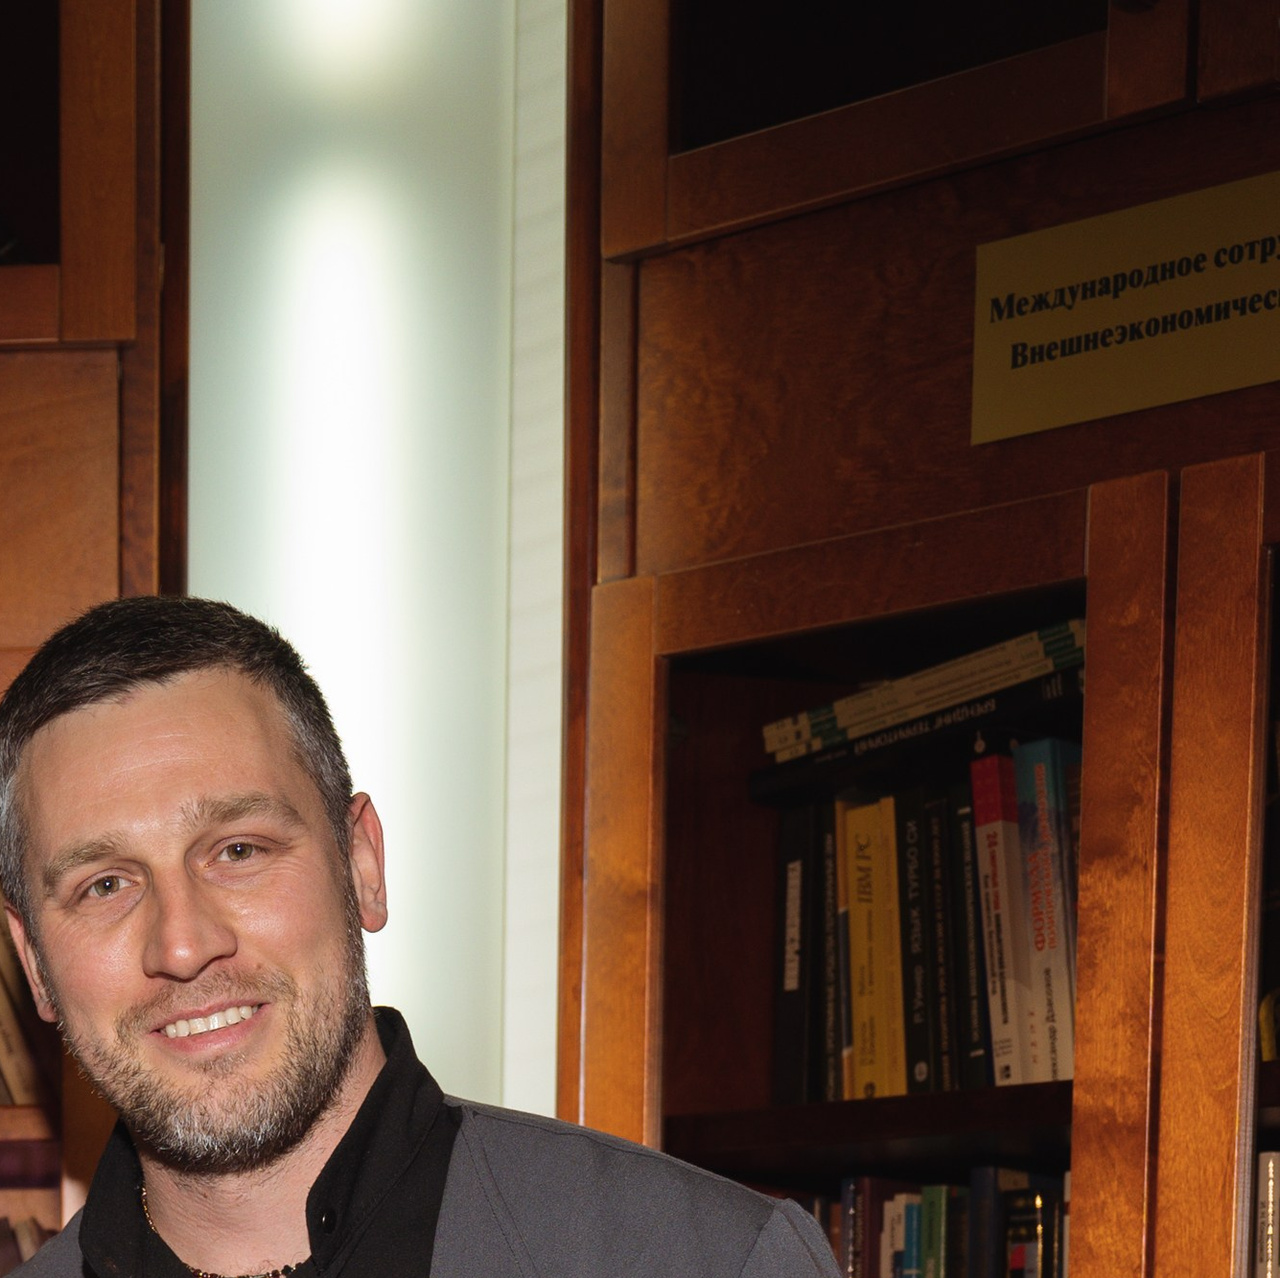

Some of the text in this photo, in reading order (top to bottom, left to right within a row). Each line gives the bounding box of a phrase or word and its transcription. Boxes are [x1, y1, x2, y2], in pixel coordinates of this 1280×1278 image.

[989, 251, 1207, 323] Международное
[854, 833, 871, 861] PC
[905, 818, 918, 845] СИ
[855, 865, 872, 904] IBM
[906, 846, 920, 901] ТУРБО
[1028, 850, 1046, 951] ФОРМУЛА
